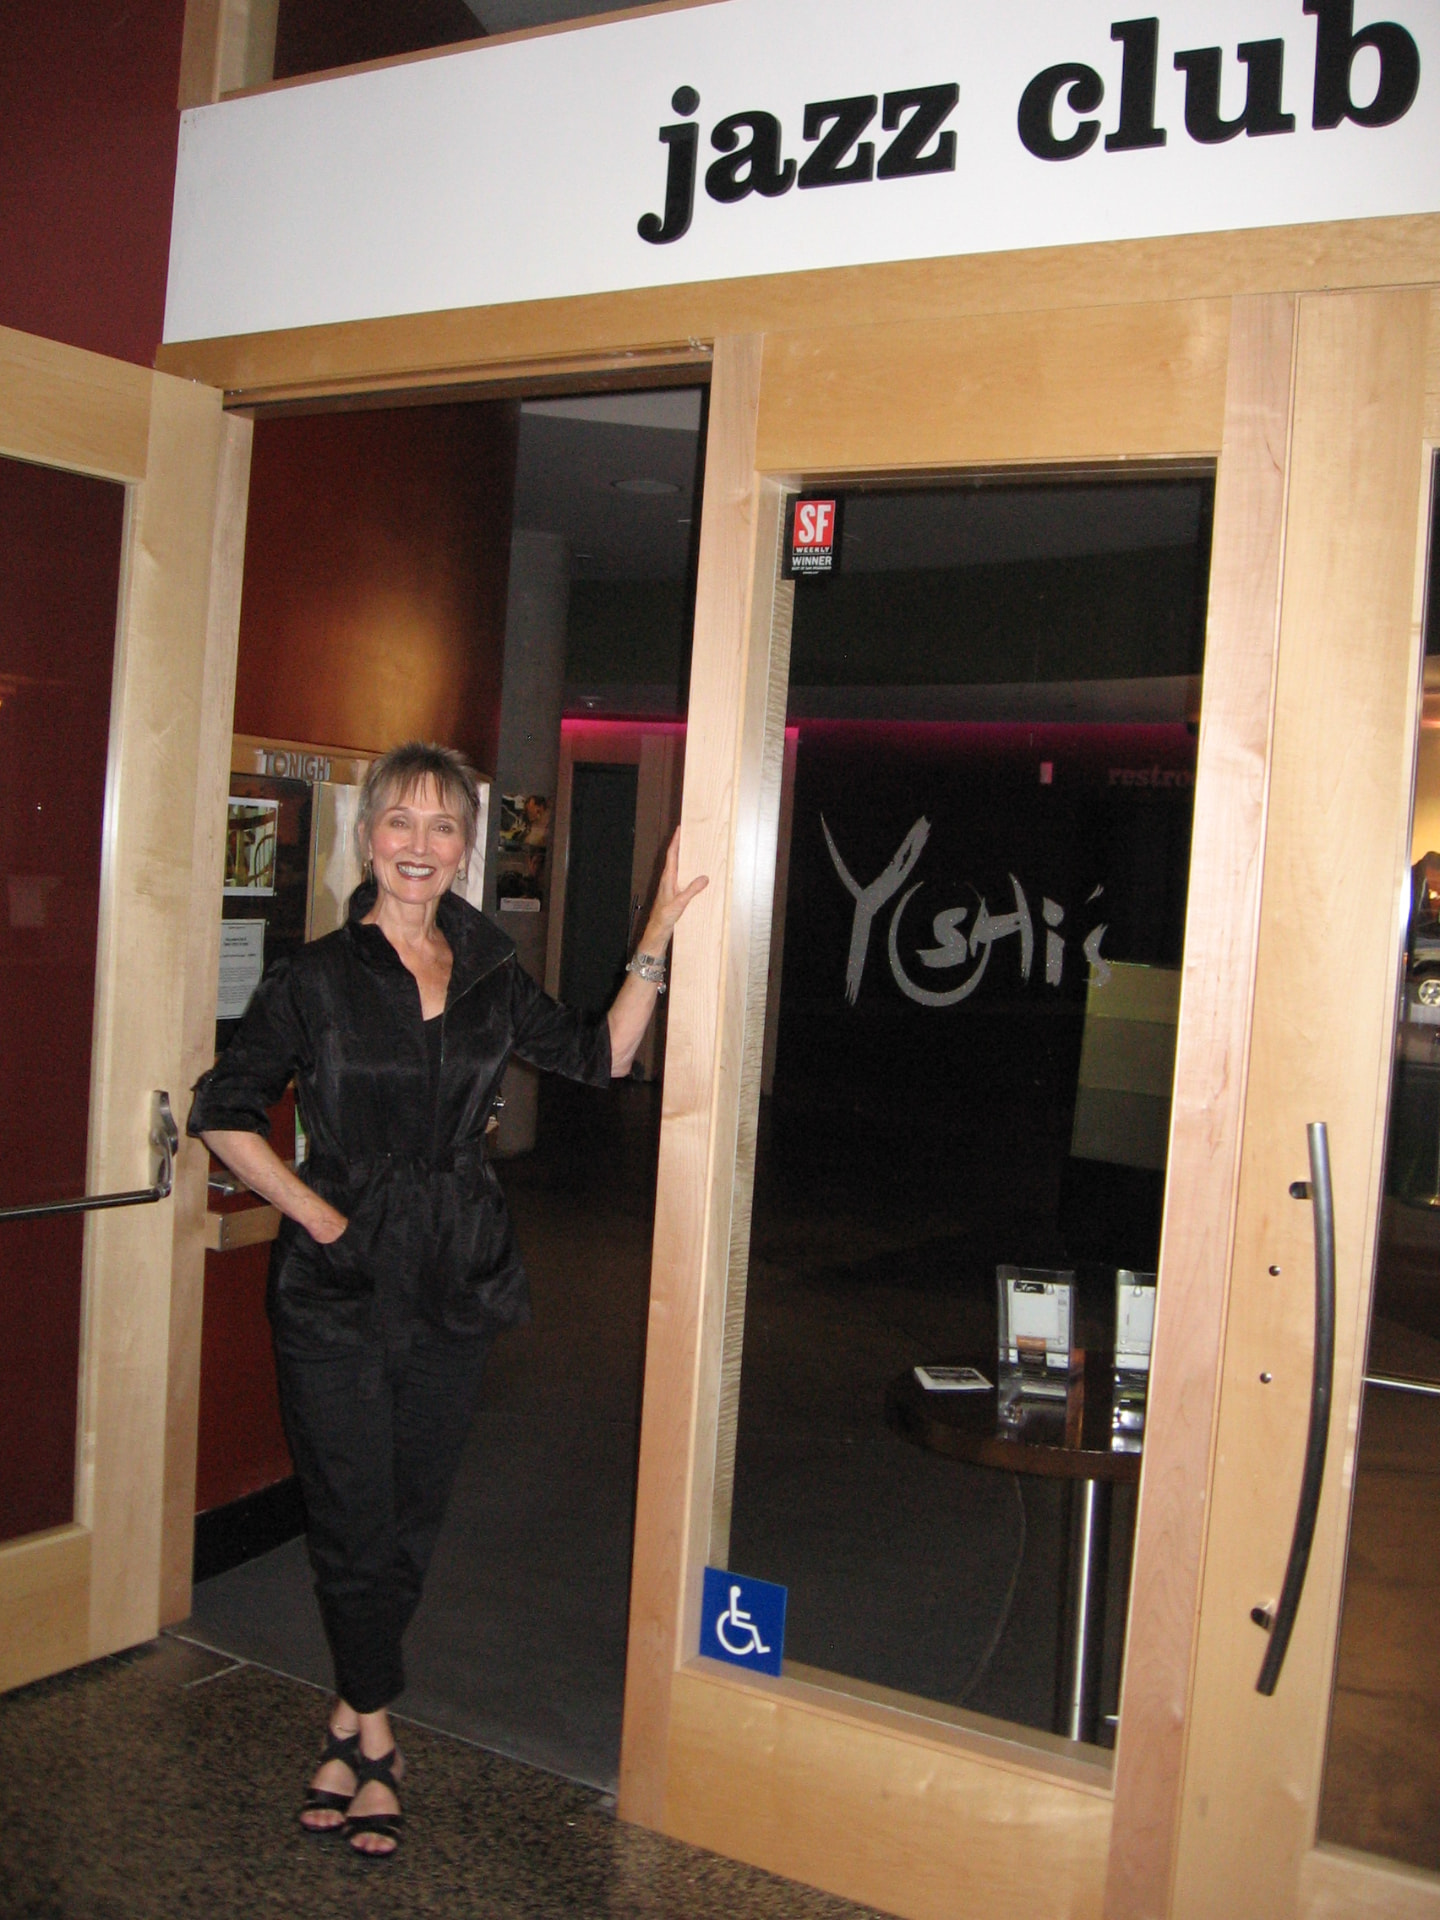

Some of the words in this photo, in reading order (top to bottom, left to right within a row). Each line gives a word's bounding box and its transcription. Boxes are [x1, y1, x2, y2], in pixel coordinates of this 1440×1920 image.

[637, 82, 960, 245] jazz
[1016, 0, 1421, 161] club
[798, 504, 832, 544] SF
[792, 556, 832, 566] WINNER
[1108, 764, 1195, 788] restro
